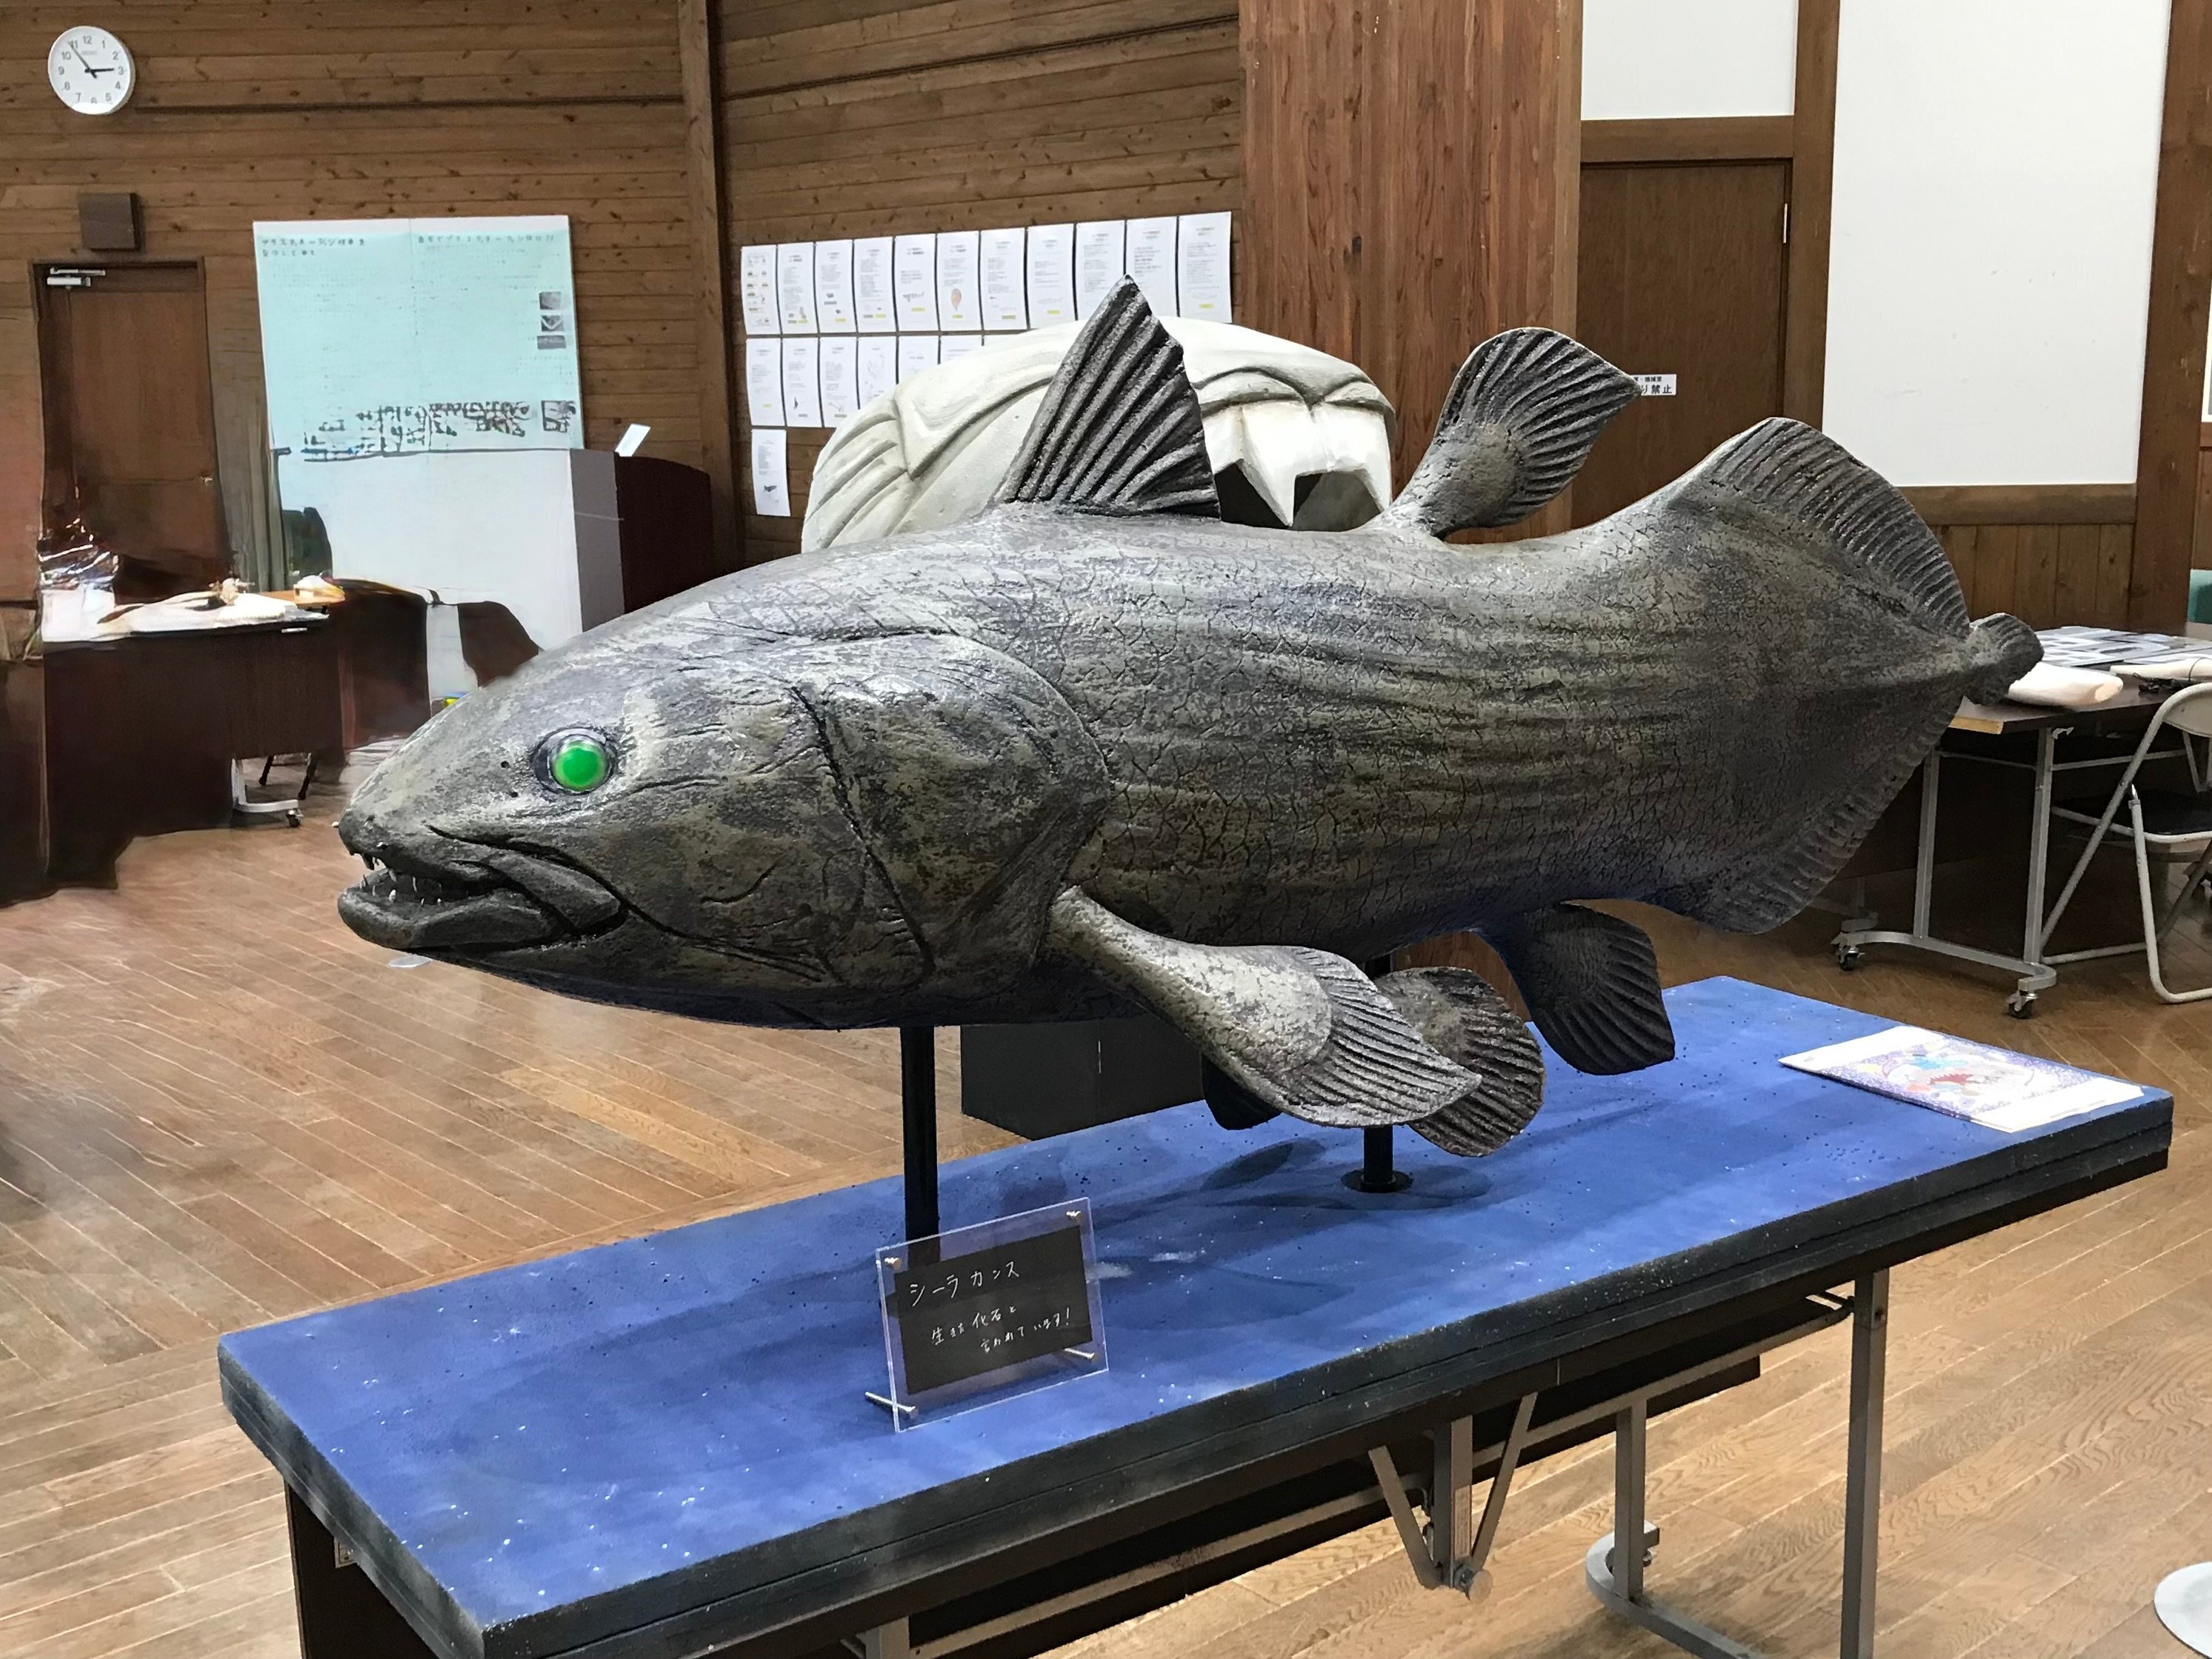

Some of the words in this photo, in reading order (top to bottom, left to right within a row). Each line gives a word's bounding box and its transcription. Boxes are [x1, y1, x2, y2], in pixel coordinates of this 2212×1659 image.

[83, 36, 92, 44] 12
[61, 50, 71, 60] 10
[113, 51, 119, 60] 2
[59, 66, 64, 75] 9
[118, 67, 124, 76] 3
[115, 81, 121, 90] 4
[76, 93, 81, 101] 7
[105, 93, 111, 101] 5
[910, 1261, 1019, 1307] シーラカンス
[931, 1306, 1016, 1346] 生きた化石と
